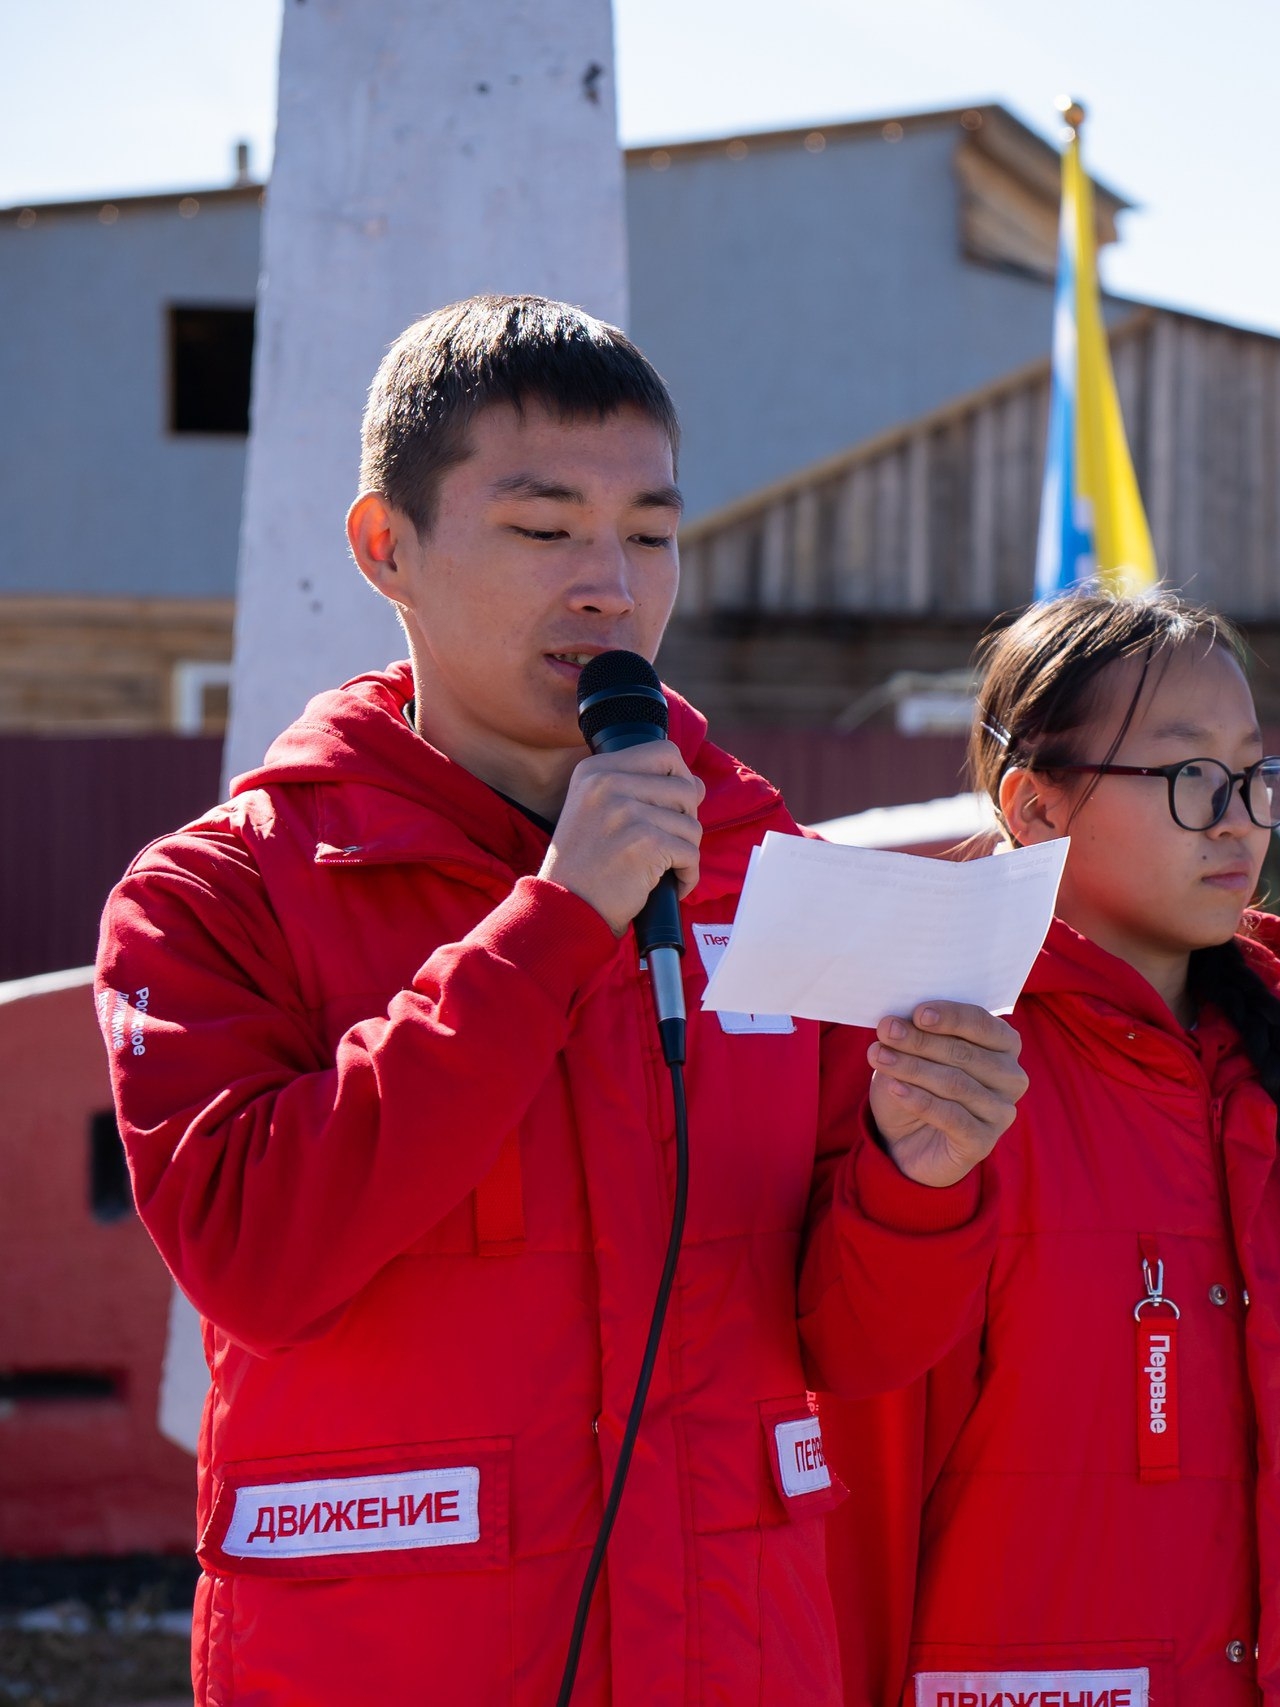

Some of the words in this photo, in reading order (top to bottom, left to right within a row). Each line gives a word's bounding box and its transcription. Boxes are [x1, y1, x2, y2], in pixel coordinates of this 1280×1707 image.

[703, 933, 731, 947] Пер
[1144, 1335, 1171, 1434] Первые
[246, 1490, 460, 1544] ДВИЖЕНИЕ
